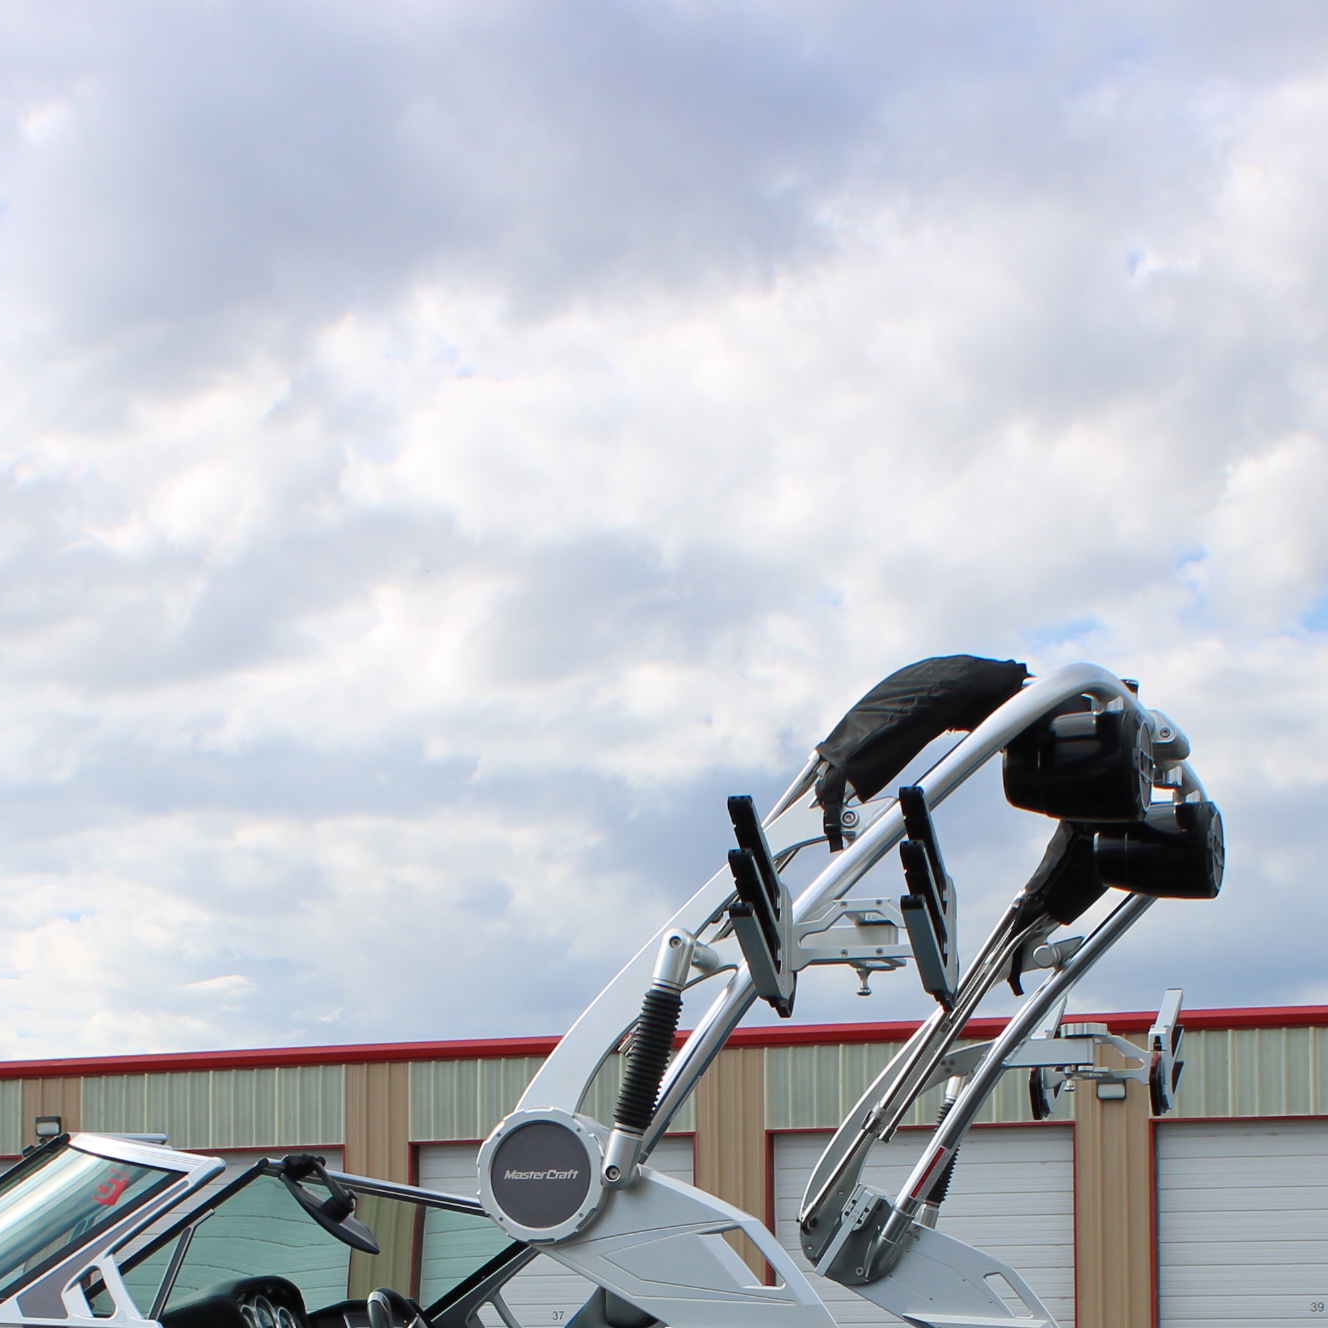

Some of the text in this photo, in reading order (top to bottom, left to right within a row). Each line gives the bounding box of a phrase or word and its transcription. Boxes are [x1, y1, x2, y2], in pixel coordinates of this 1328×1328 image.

[504, 1169, 579, 1180] MasterCraft
[1310, 1302, 1325, 1313] 39
[552, 1311, 565, 1320] 37
